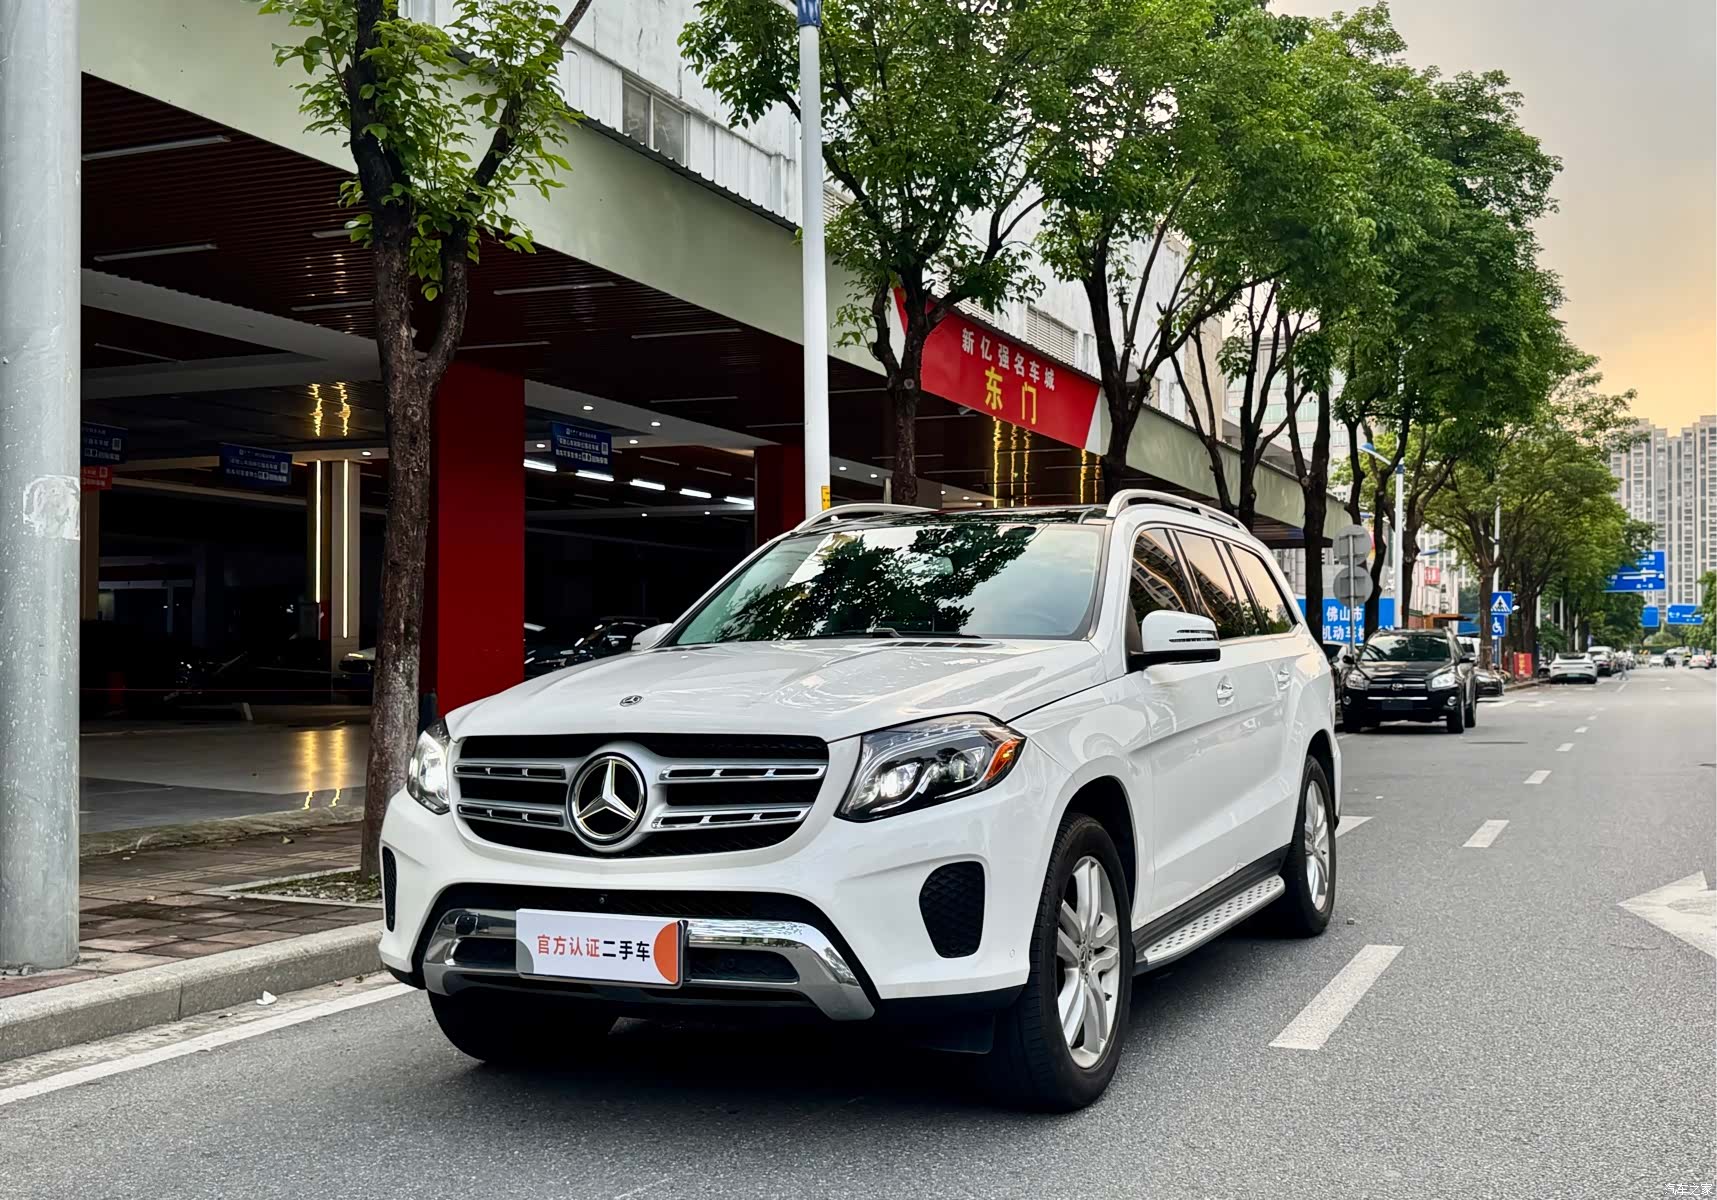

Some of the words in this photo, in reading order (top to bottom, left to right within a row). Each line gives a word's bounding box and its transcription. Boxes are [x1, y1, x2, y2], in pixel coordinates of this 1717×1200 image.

[962, 328, 1055, 390] 新亿强名车城
[985, 366, 1037, 425] 东门
[1326, 606, 1364, 622] 佛山市
[537, 934, 651, 962] 官方认证二手车
